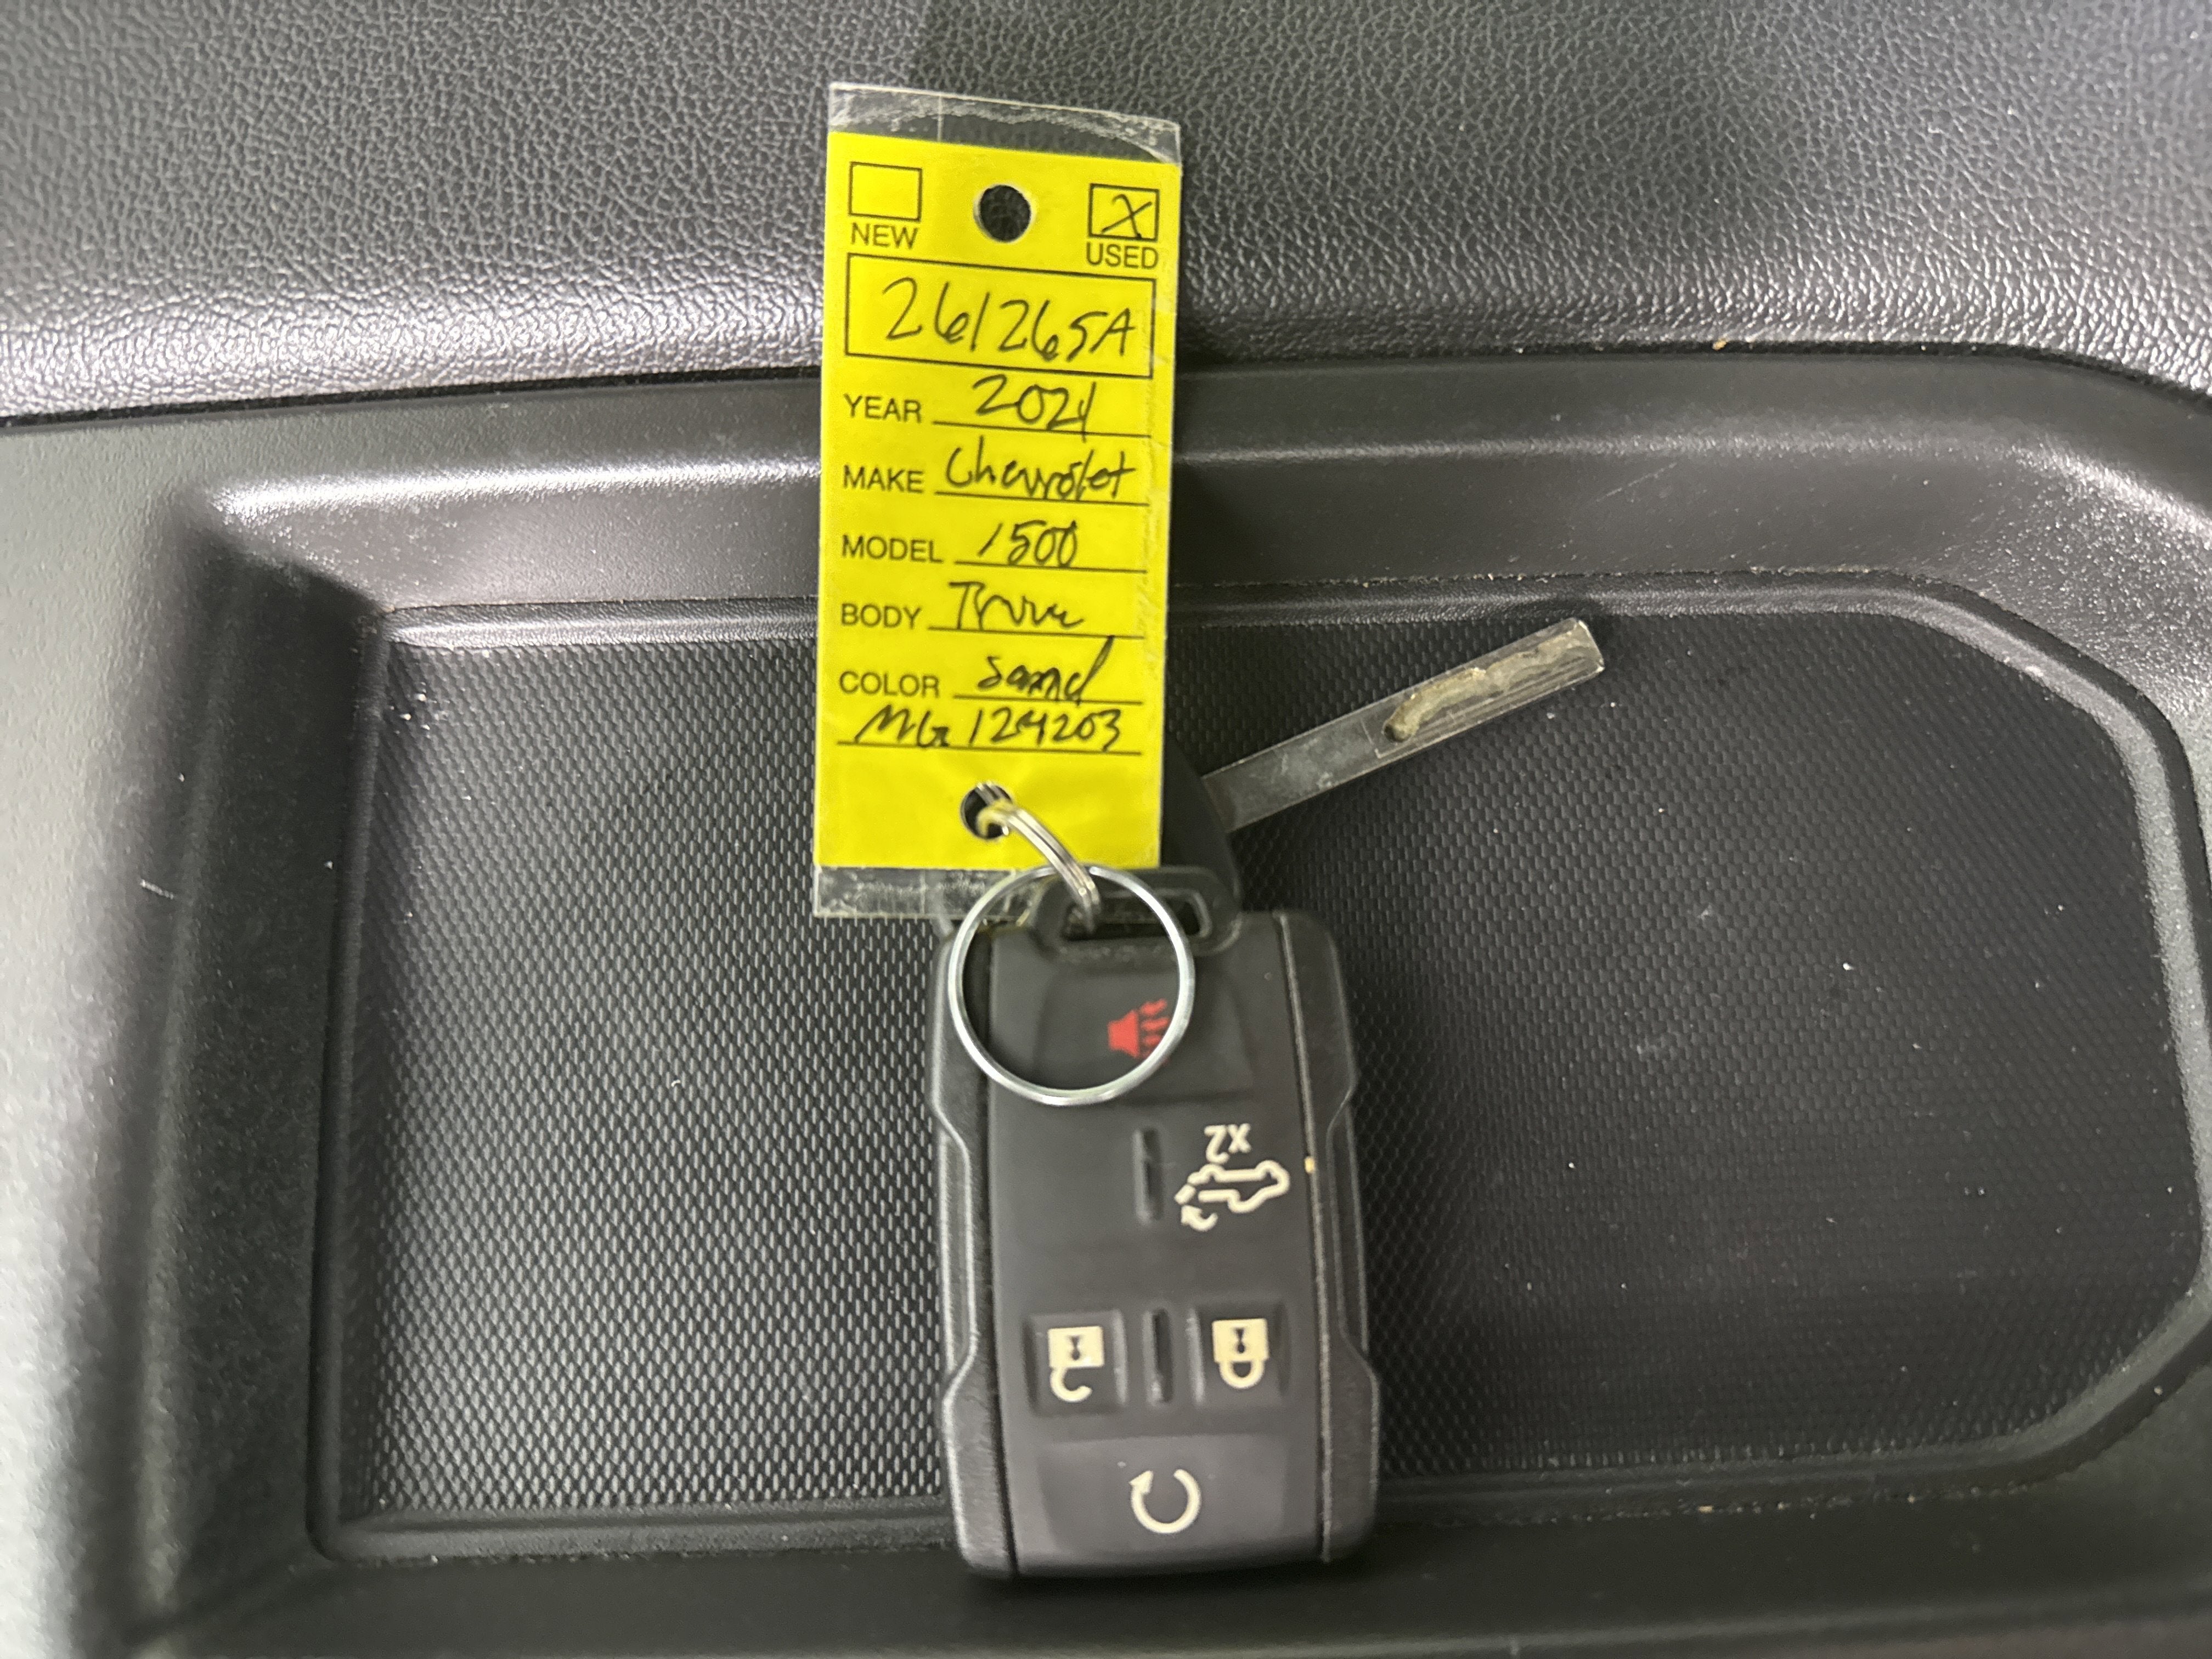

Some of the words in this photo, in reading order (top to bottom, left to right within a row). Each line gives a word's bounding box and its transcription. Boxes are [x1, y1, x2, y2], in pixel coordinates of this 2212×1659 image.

[851, 223, 919, 249] NEW
[1086, 243, 1159, 269] USED
[843, 394, 922, 424] YEAR
[843, 465, 924, 493] MAKE
[842, 535, 944, 564] MODEL
[978, 520, 1078, 567] 1500
[841, 602, 922, 629] BODY
[839, 670, 940, 698] COLOR
